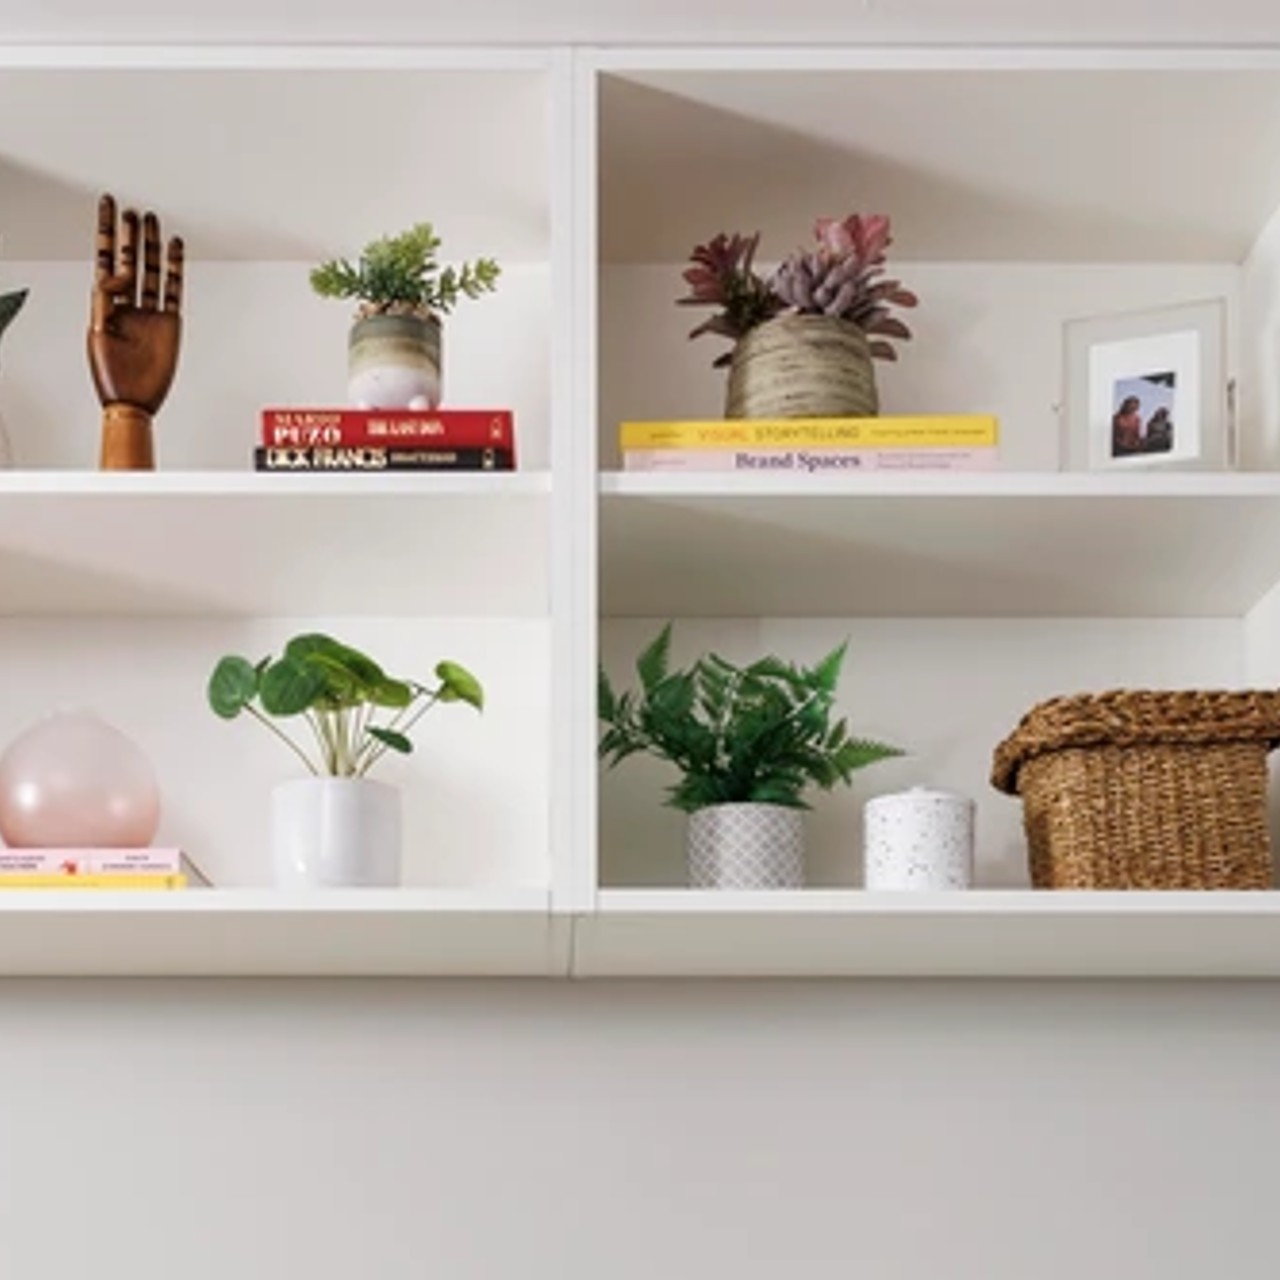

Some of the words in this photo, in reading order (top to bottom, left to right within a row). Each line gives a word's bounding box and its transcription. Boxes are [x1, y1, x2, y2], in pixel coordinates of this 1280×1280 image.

[274, 413, 342, 425] MARIO
[274, 426, 342, 445] PUZO
[697, 427, 748, 442] VISUAL
[754, 426, 861, 441] STORYTELLING
[266, 447, 311, 468] DICK
[313, 447, 388, 468] FRANCIS
[736, 452, 793, 469] Brand
[797, 452, 861, 473] Spaces
